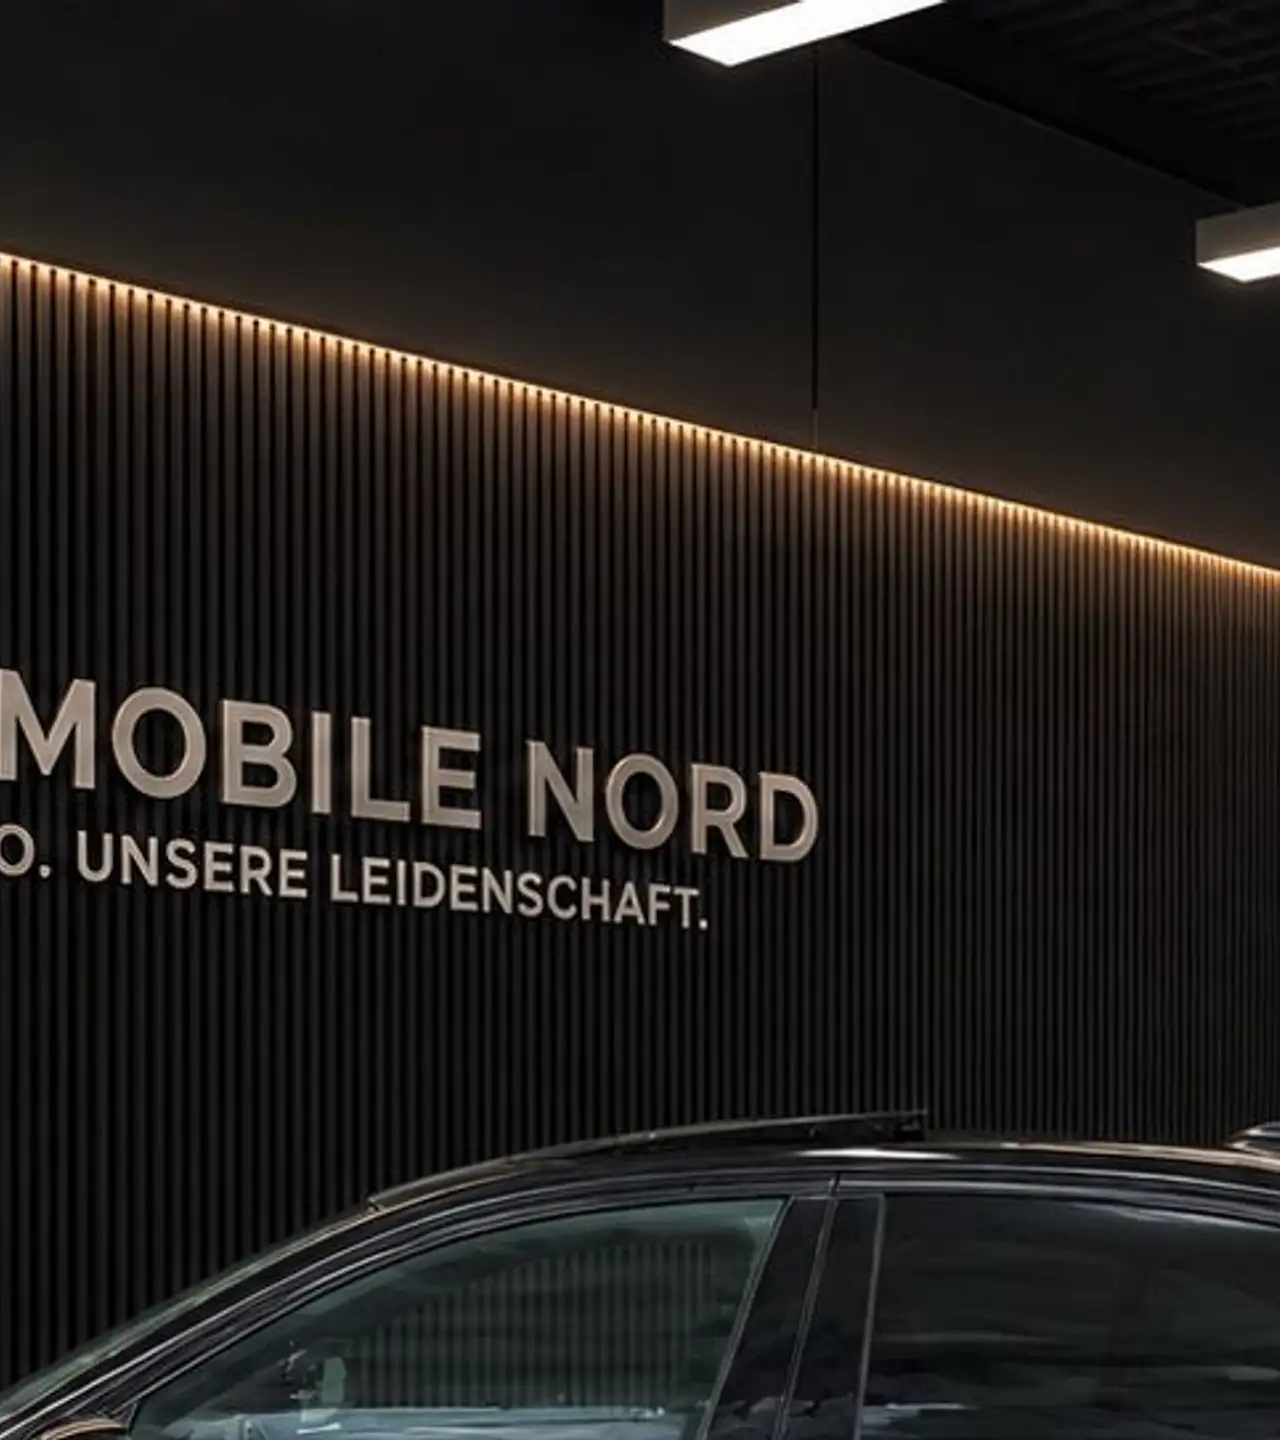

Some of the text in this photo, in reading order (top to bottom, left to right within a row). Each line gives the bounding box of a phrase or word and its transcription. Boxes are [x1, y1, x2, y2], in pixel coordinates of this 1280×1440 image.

[527, 740, 819, 862] NORD
[76, 830, 309, 899] UNSERE
[330, 853, 709, 930] LEIDENSCHAFT.
